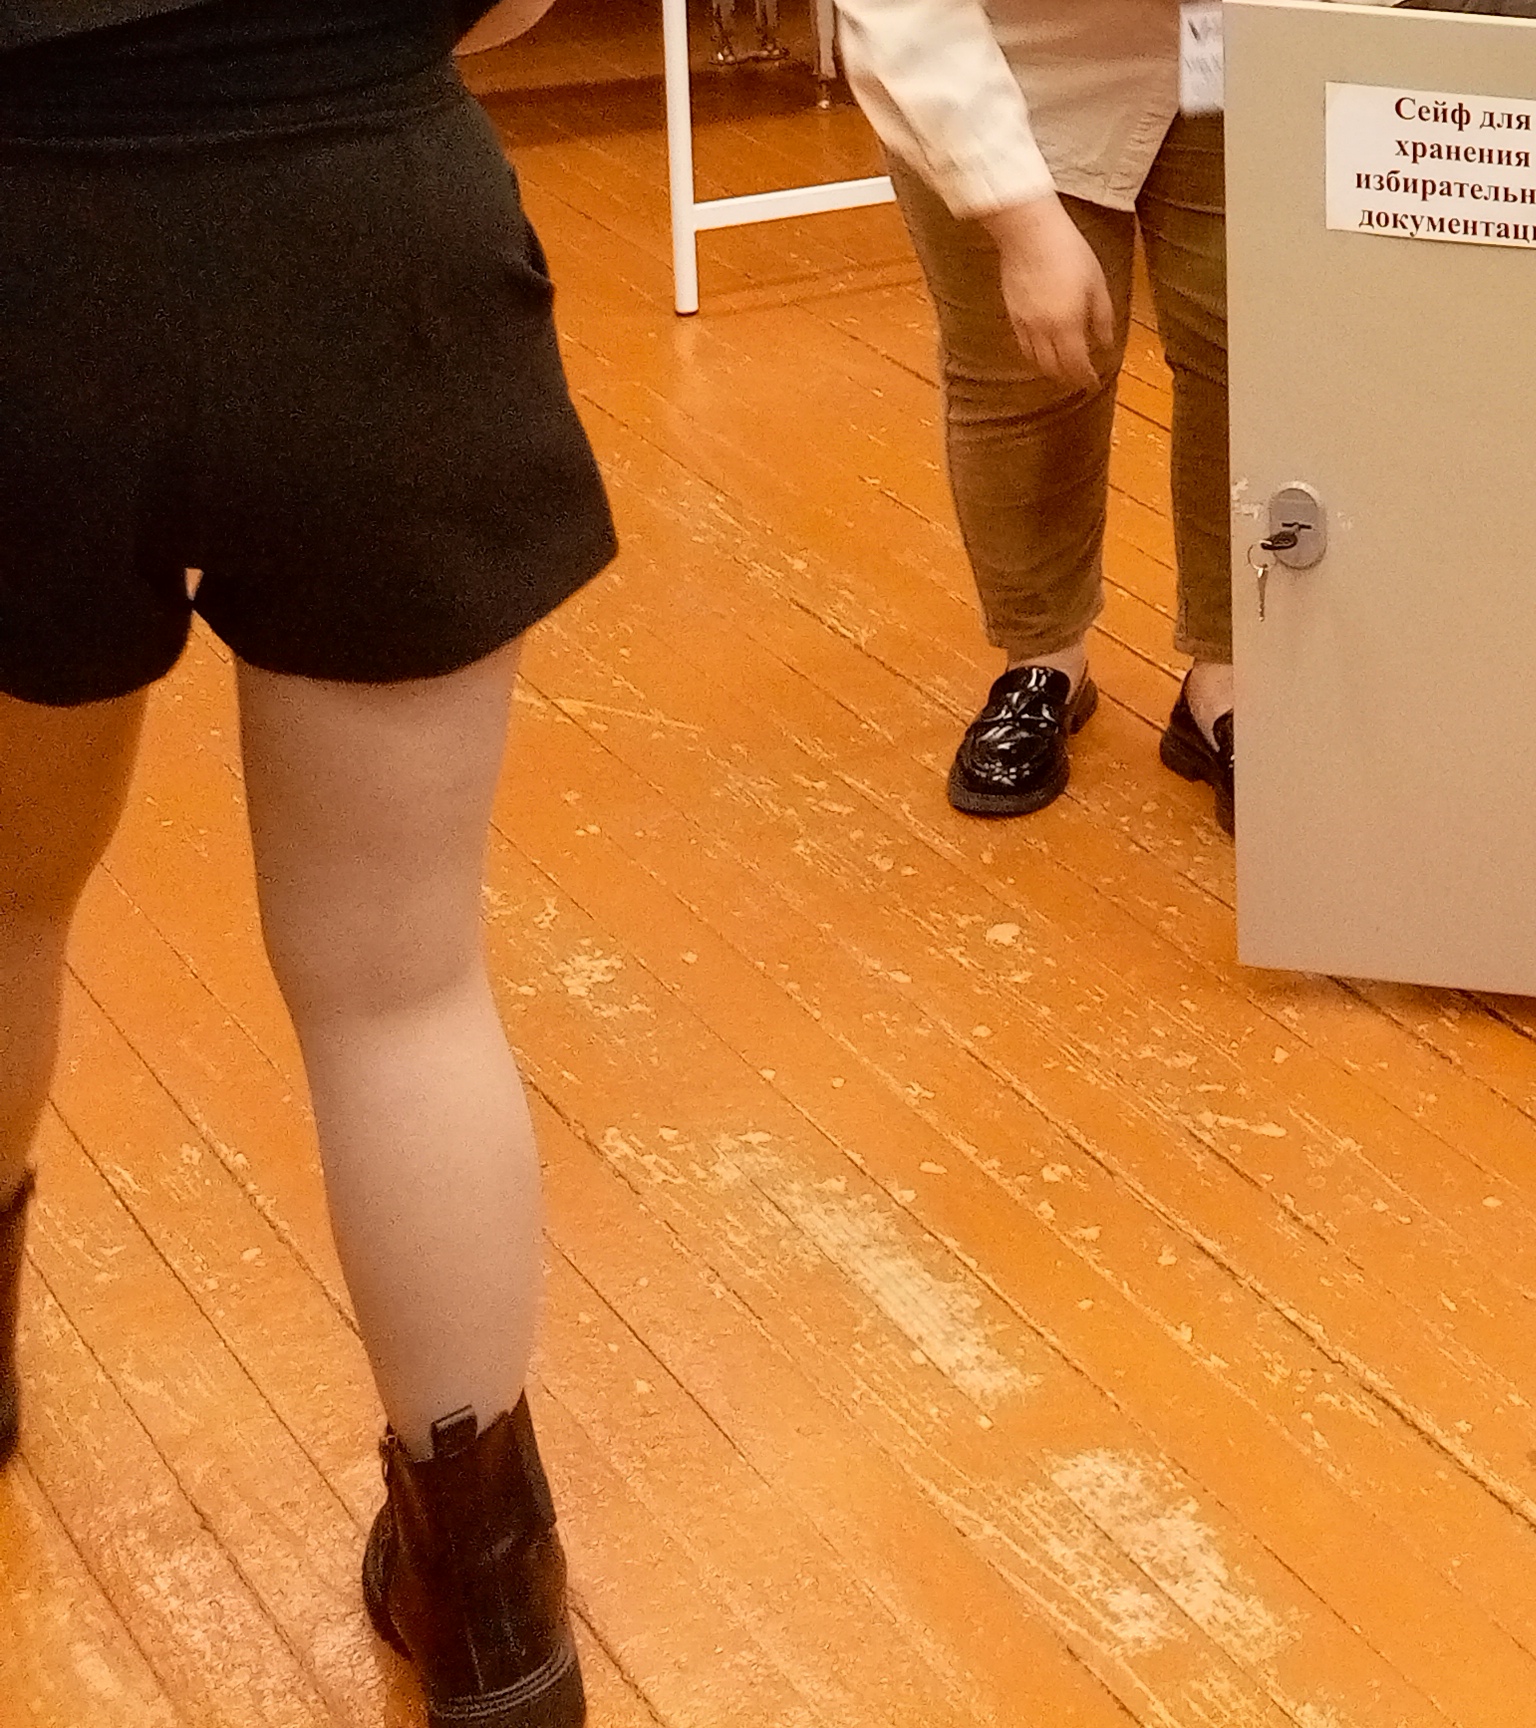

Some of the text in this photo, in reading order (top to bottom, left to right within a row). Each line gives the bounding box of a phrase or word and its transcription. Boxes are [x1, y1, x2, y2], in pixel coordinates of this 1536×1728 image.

[1394, 95, 1532, 134] Сейф для
[1394, 137, 1532, 169] хранения
